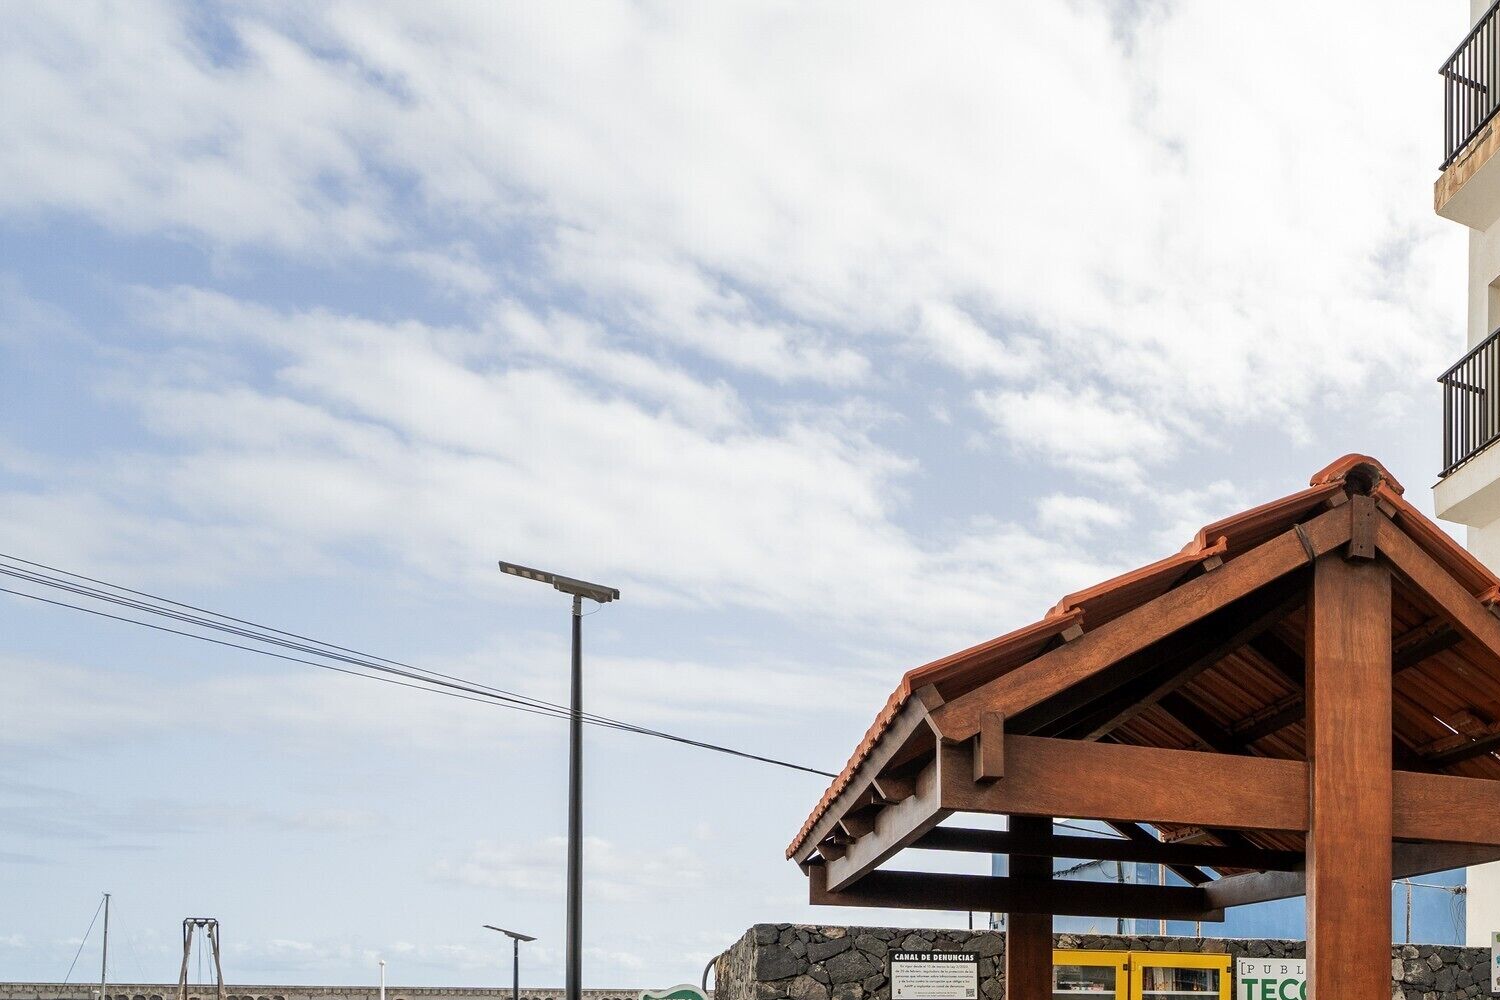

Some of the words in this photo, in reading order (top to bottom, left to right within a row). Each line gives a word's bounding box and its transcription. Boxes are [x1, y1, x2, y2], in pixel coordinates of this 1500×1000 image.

[894, 953, 919, 961] CANAL
[921, 953, 931, 961] DE
[933, 953, 974, 961] DENUNCIAS
